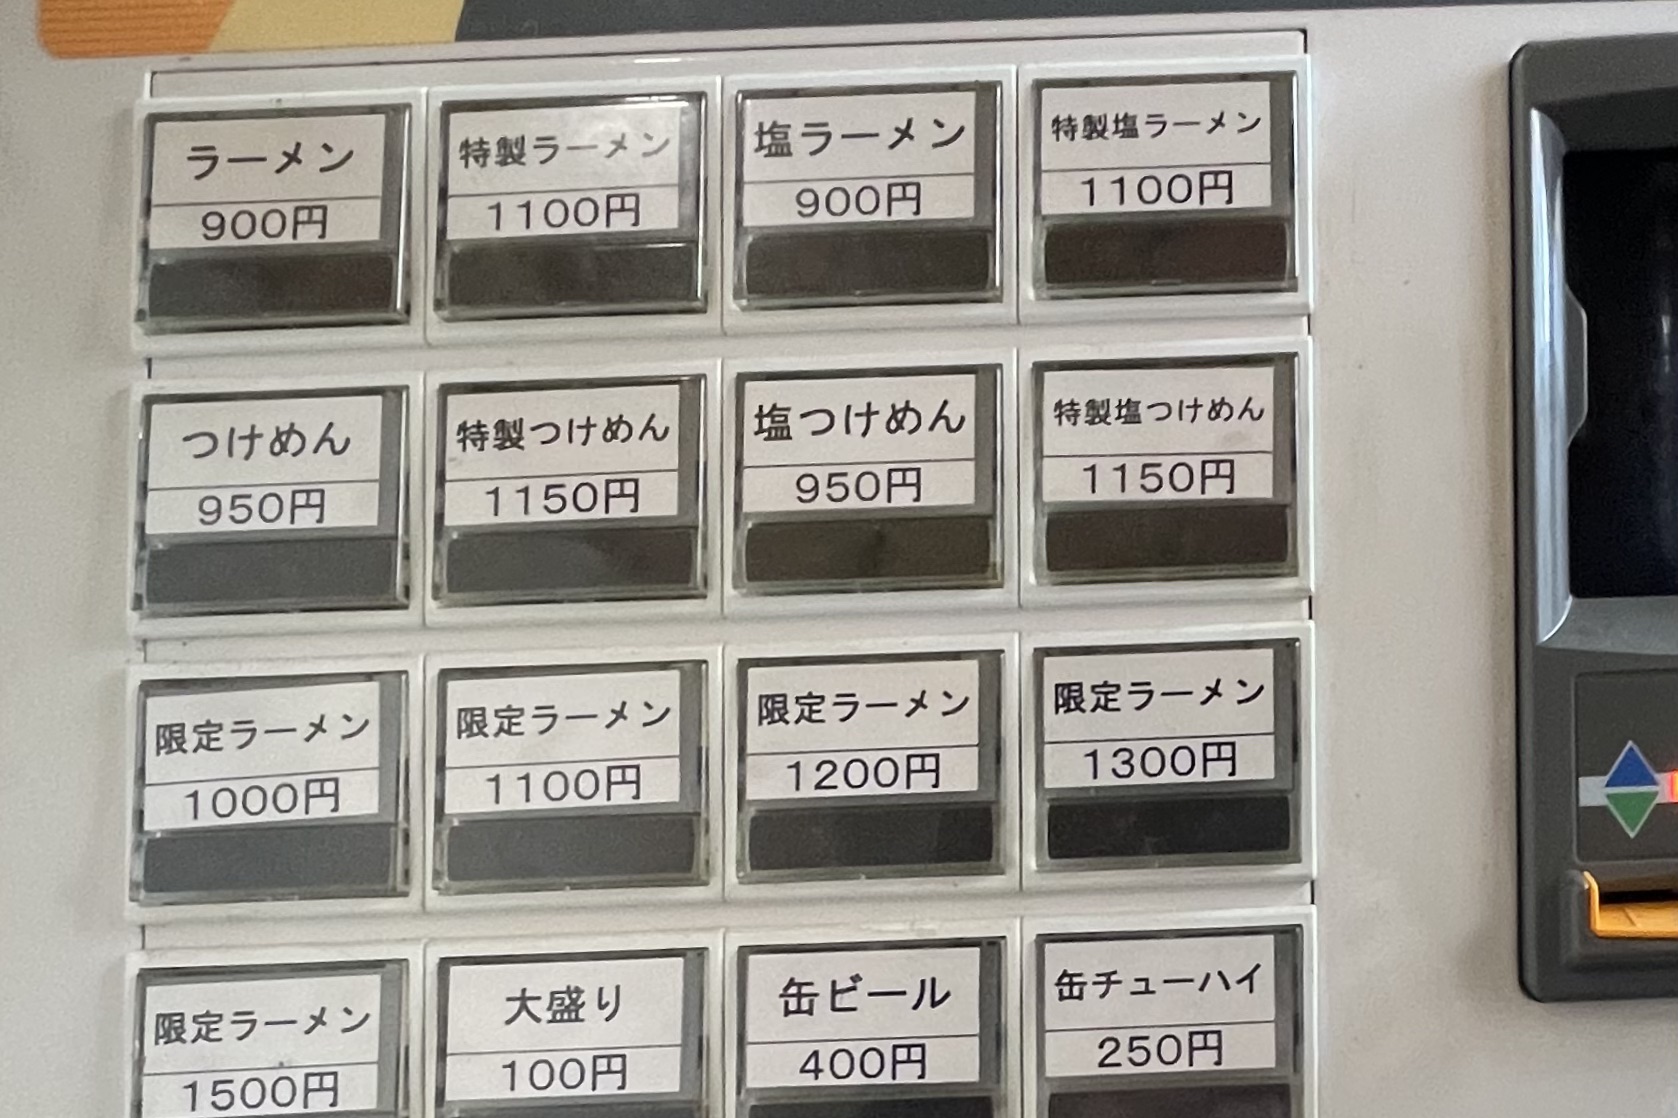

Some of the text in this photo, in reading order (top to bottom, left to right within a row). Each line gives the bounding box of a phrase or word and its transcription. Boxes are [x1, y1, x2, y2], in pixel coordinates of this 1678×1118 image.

[754, 117, 966, 158] 塩ラーメン
[1052, 110, 1262, 143] 特製塩ラーメン
[187, 142, 353, 180] ラーメン
[459, 133, 669, 169] 特製ラーメン
[796, 182, 921, 218] 900円
[1082, 170, 1233, 206] 1100円
[202, 205, 328, 241] 900円
[487, 193, 640, 230] 1100円
[754, 399, 965, 441] 塩つけめん
[1054, 397, 1264, 426] 特製塩つけめん
[182, 422, 350, 461] つけめん
[457, 413, 669, 452] 特製つけめん
[796, 467, 921, 503] 950円
[1083, 459, 1234, 495] 1150円
[199, 489, 325, 525] 950円
[485, 478, 639, 516] 1150円
[758, 690, 969, 726] 限定ラーメン
[1055, 678, 1264, 715] 限定ラーメン
[156, 714, 369, 756] 限定ラーメン
[457, 701, 671, 739] 限定ラーメン
[786, 753, 940, 791] 1200円
[1085, 741, 1236, 779] 1300円
[186, 777, 339, 820] 1000円
[486, 764, 640, 804] 1100円
[779, 974, 951, 1017] 缶ビール
[1054, 963, 1261, 1002] 缶チューハイ
[505, 985, 620, 1025] 大盛り
[155, 1007, 370, 1046] 限定ラーメン
[799, 1043, 926, 1080] 400円
[1098, 1030, 1222, 1068] 250円
[183, 1071, 338, 1112] 1500円
[502, 1054, 626, 1091] 100円
